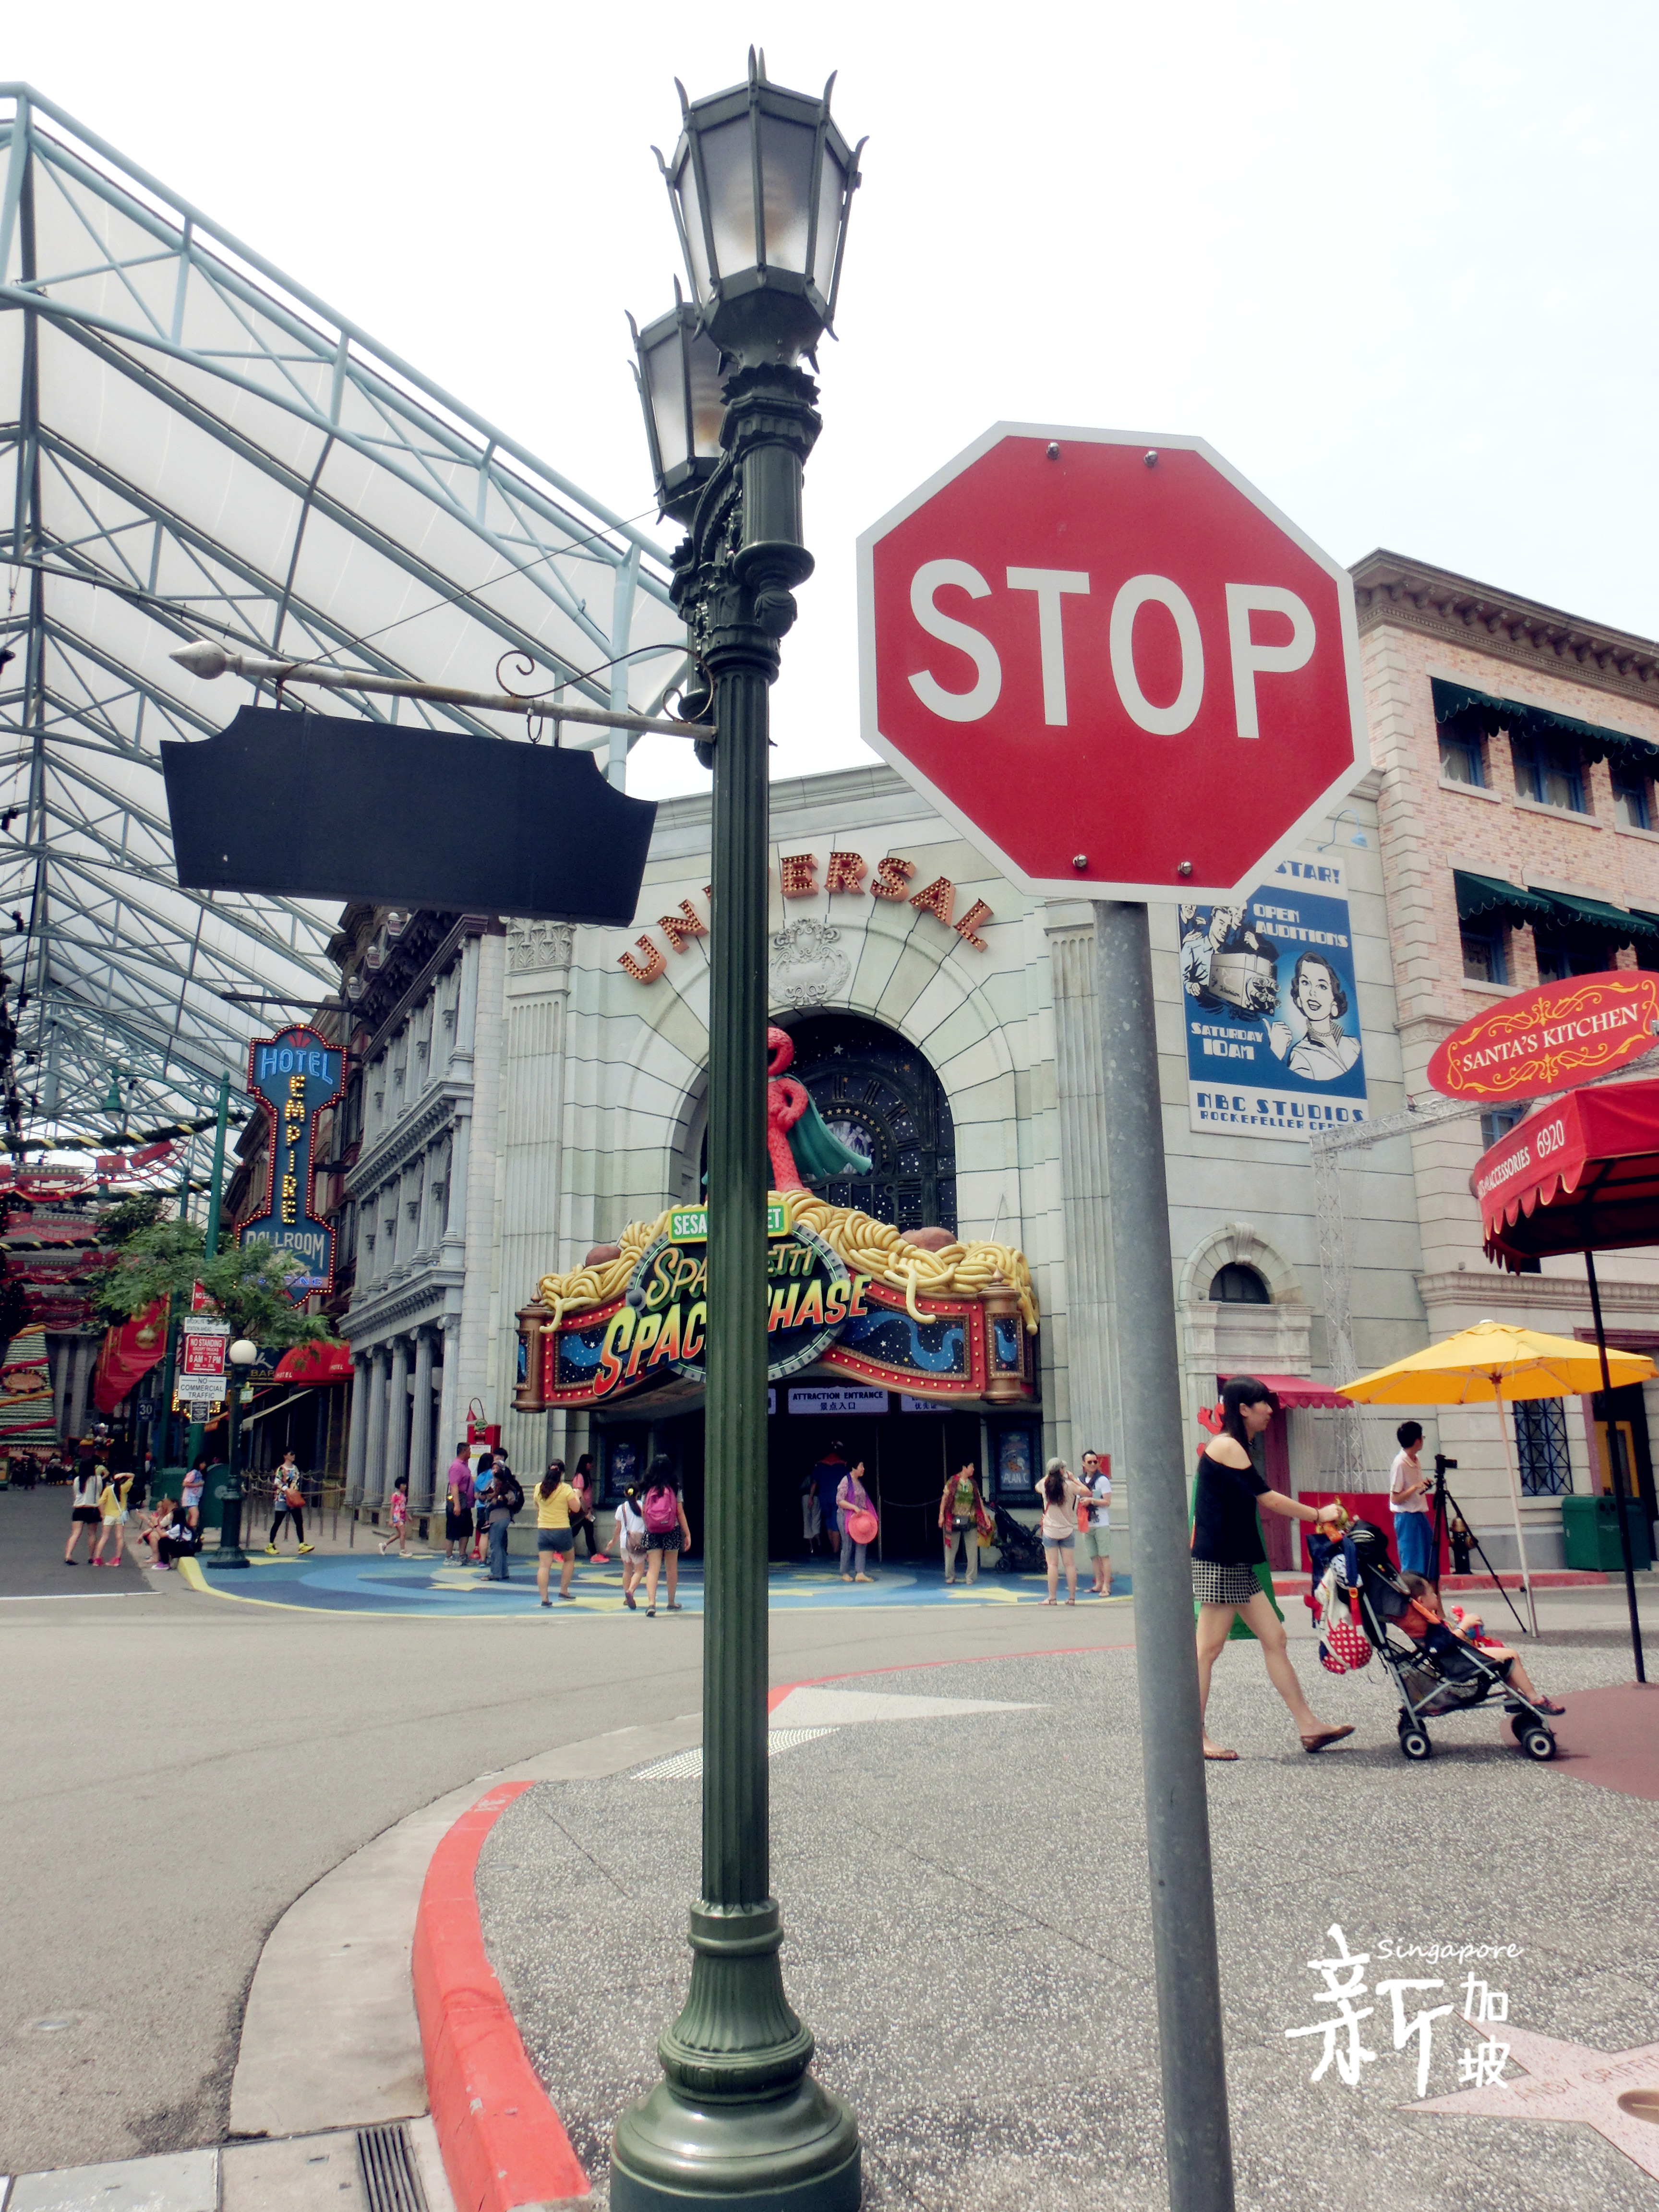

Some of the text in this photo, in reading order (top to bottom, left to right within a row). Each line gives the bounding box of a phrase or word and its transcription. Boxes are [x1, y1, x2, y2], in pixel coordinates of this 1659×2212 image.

[908, 558, 1316, 739] STOP
[617, 852, 994, 984] UNERSAL
[1253, 903, 1299, 923] OPEN
[1256, 921, 1348, 948] AUDITIONS
[1191, 1022, 1263, 1042] SATURDAY
[1464, 1003, 1638, 1071] SANTA'S KITCHEN
[261, 1048, 333, 1084] HOTEL
[1197, 1093, 1364, 1122] NBC STUDIOS
[1201, 1110, 1304, 1129] ROCKEFELLER
[282, 1075, 305, 1224] EMPIRE
[1489, 1146, 1530, 1190] ACCESSORIES
[1537, 1119, 1564, 1158] 6920
[674, 1213, 707, 1235] SESA
[199, 1338, 222, 1347] STANDING
[593, 1274, 872, 1397] SPAC HASE
[793, 1392, 840, 1400] ATTRACTION
[820, 1402, 856, 1411] 景点入口
[139, 1404, 153, 1415] 30
[1003, 1473, 1022, 1483] PLAN
